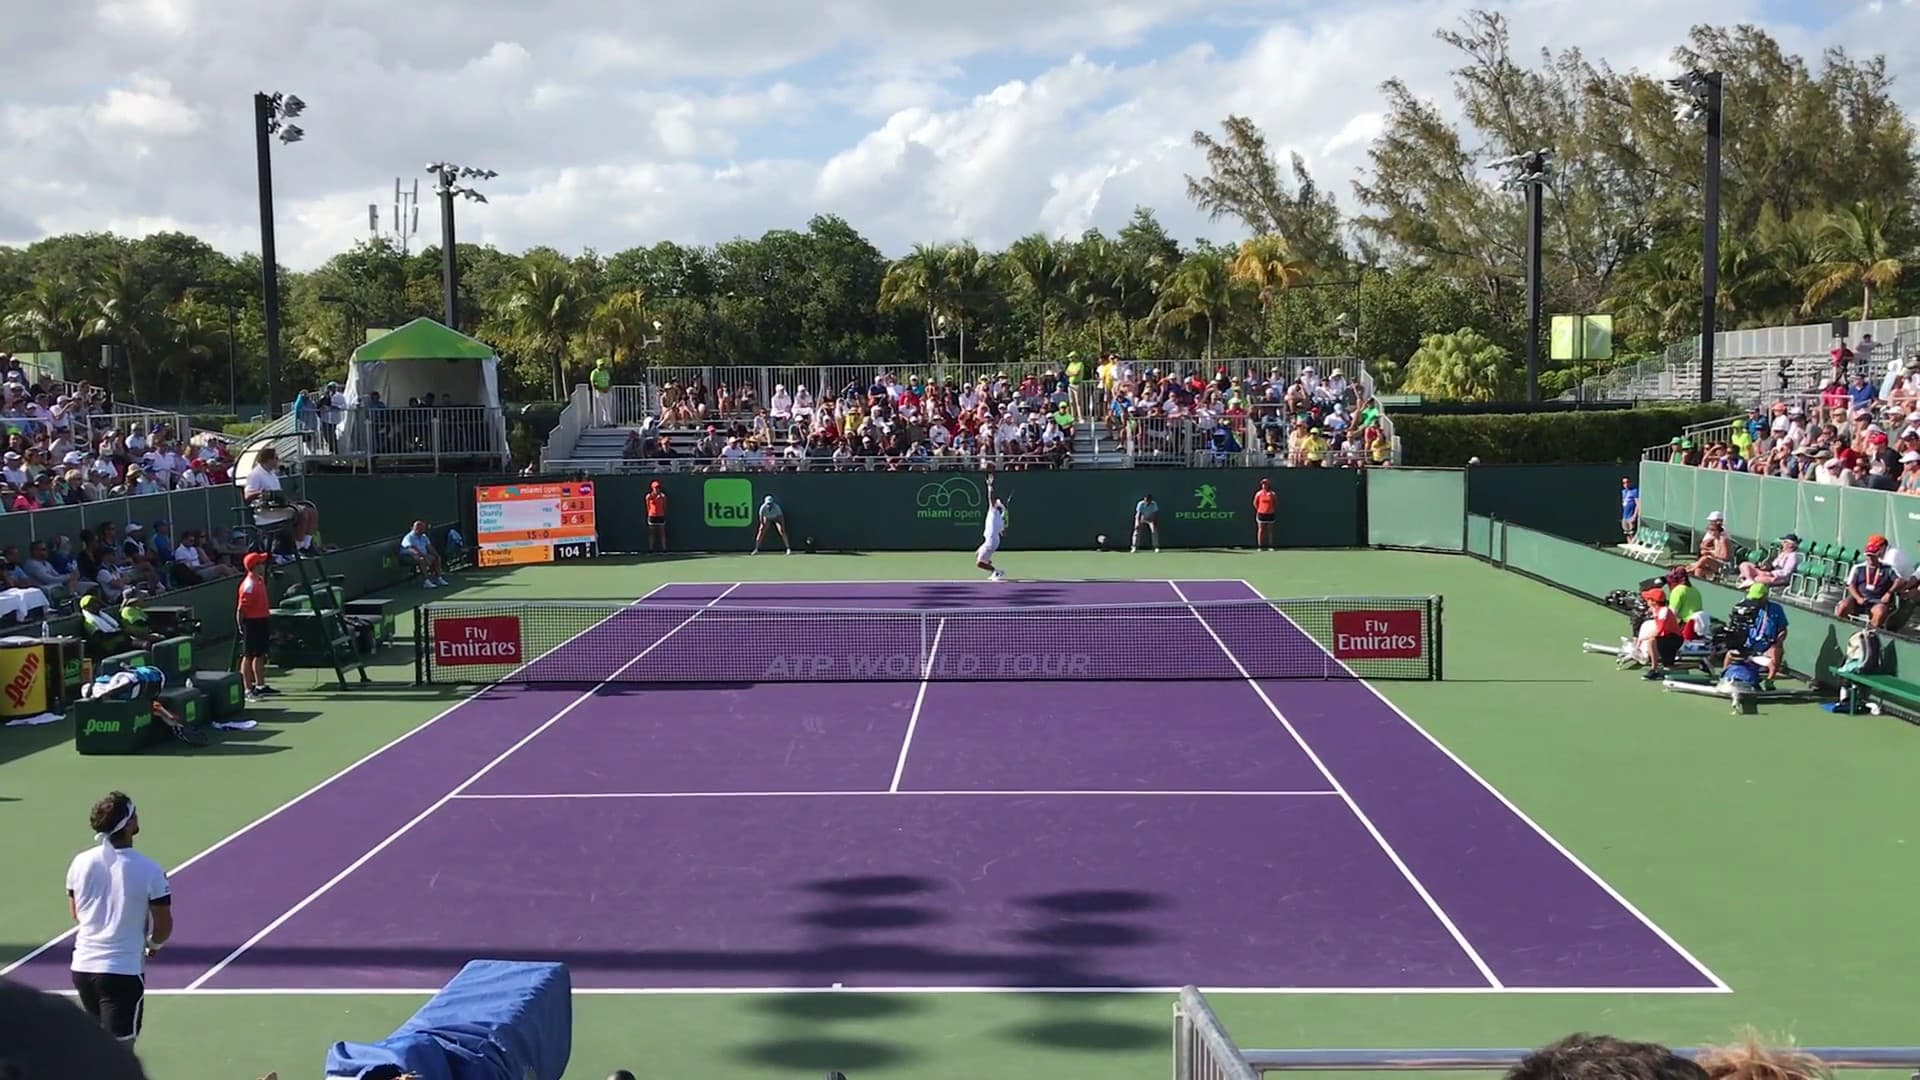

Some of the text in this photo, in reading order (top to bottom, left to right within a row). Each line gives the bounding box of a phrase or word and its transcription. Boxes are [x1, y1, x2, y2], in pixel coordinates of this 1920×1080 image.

[562, 501, 569, 511] 6
[707, 502, 749, 519] Itaú
[571, 514, 578, 524] 6
[580, 515, 585, 524] 5
[917, 508, 981, 520] miami open
[1175, 511, 1236, 519] PEUGEOT
[559, 546, 580, 558] 104
[1365, 619, 1388, 633] Fly
[465, 626, 488, 641] Fly
[439, 639, 516, 657] Emirates
[1337, 632, 1416, 650] Emirates
[763, 653, 835, 677] ATP
[993, 652, 1092, 675] TOUR
